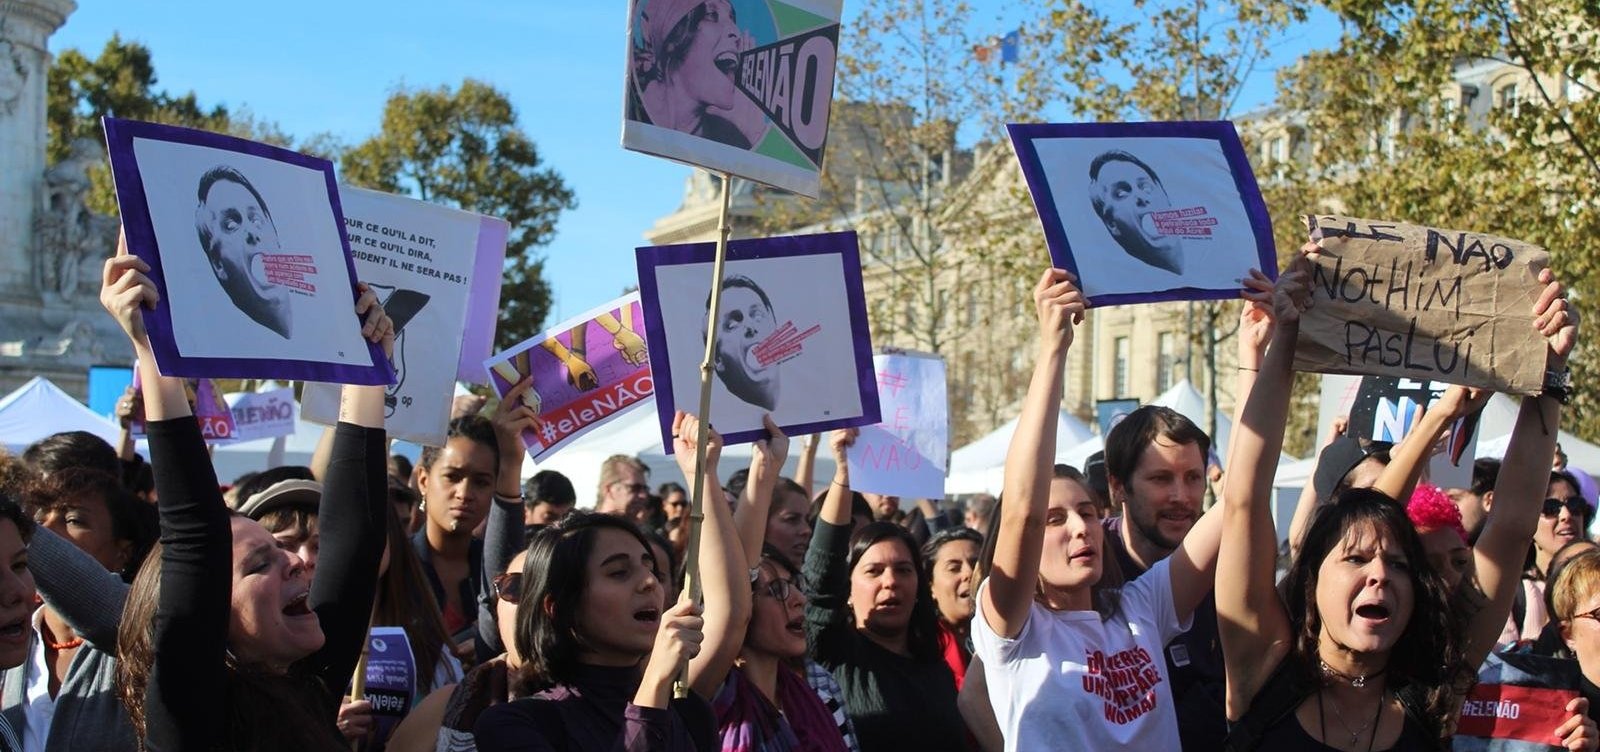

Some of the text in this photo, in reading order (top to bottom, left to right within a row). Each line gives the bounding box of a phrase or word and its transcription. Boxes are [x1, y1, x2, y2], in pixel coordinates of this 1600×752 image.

[740, 36, 836, 150] #ELENÃO
[347, 233, 433, 262] UR CE QU'IL DIRA,
[366, 223, 379, 233] CE
[381, 227, 407, 240] QU'IL
[409, 234, 417, 243] A
[418, 235, 437, 248] DIT,
[389, 258, 398, 268] IL
[401, 260, 414, 271] NE
[416, 266, 441, 279] SERA
[443, 272, 461, 284] PAS
[463, 276, 468, 285] !
[541, 376, 654, 441] #eleNÃO
[1462, 700, 1520, 720] #ELENÃO
